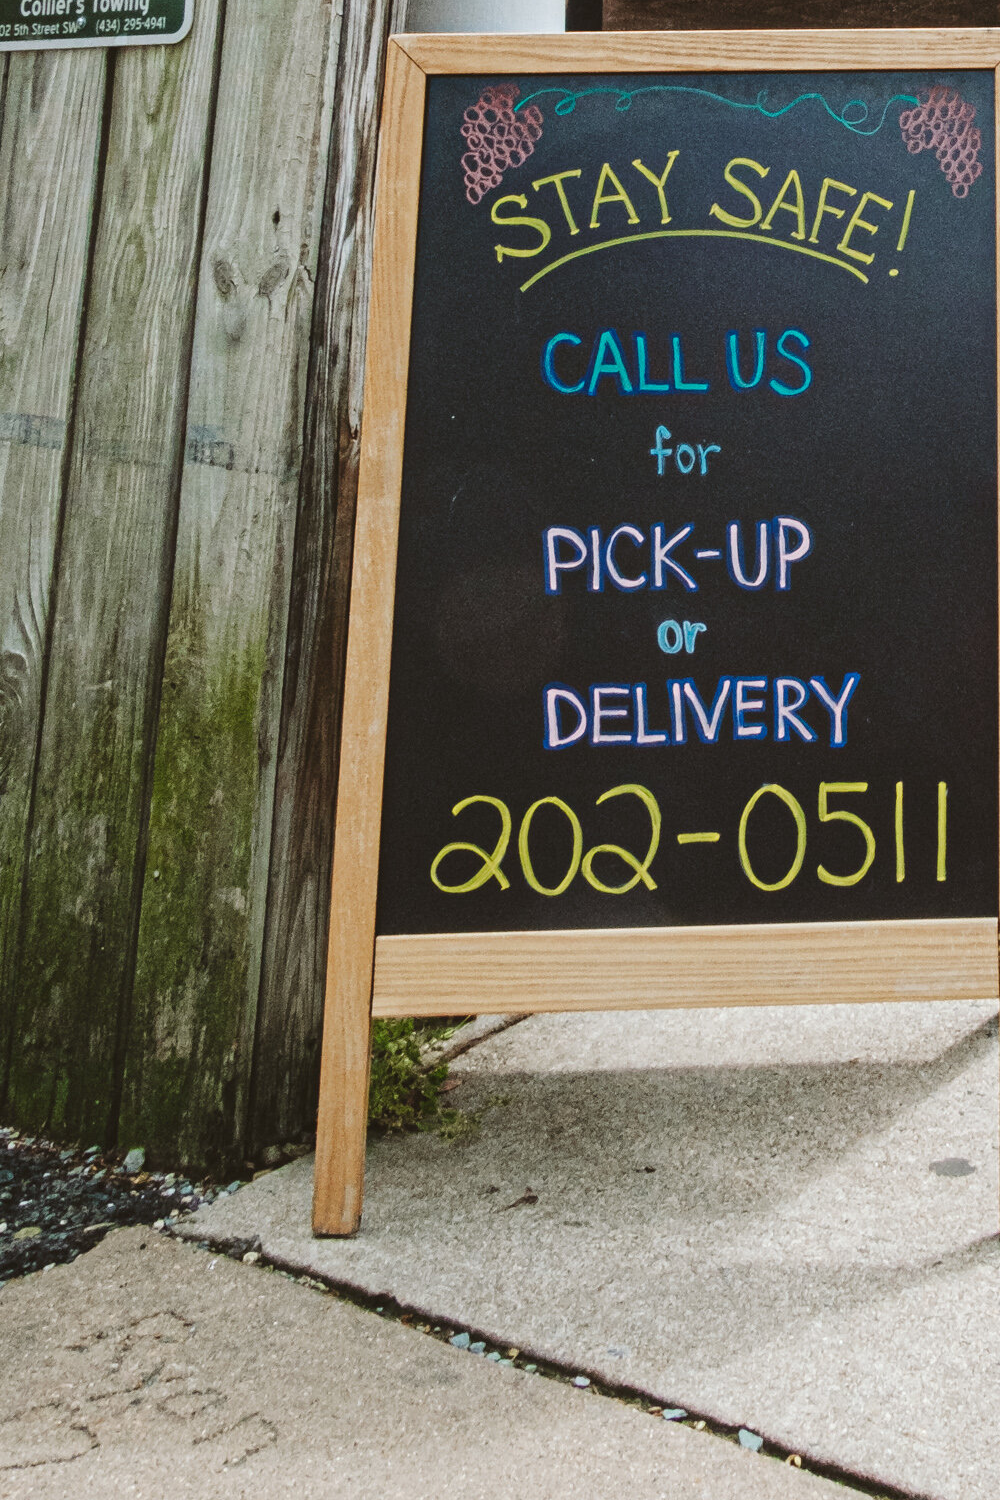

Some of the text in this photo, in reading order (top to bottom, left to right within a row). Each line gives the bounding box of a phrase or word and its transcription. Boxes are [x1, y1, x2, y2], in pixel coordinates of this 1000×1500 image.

[13, 23, 29, 37] 5th
[31, 22, 60, 36] Street
[95, 19, 121, 35] (434)
[123, 16, 167, 31] 295-4941
[489, 150, 915, 278] STAY SAFE!
[541, 328, 812, 397] CALL US
[649, 424, 721, 477] for
[543, 516, 812, 594] PICK-UP
[657, 619, 707, 655] or
[542, 672, 861, 750] DELIVERY
[429, 781, 949, 897] 202-0511
